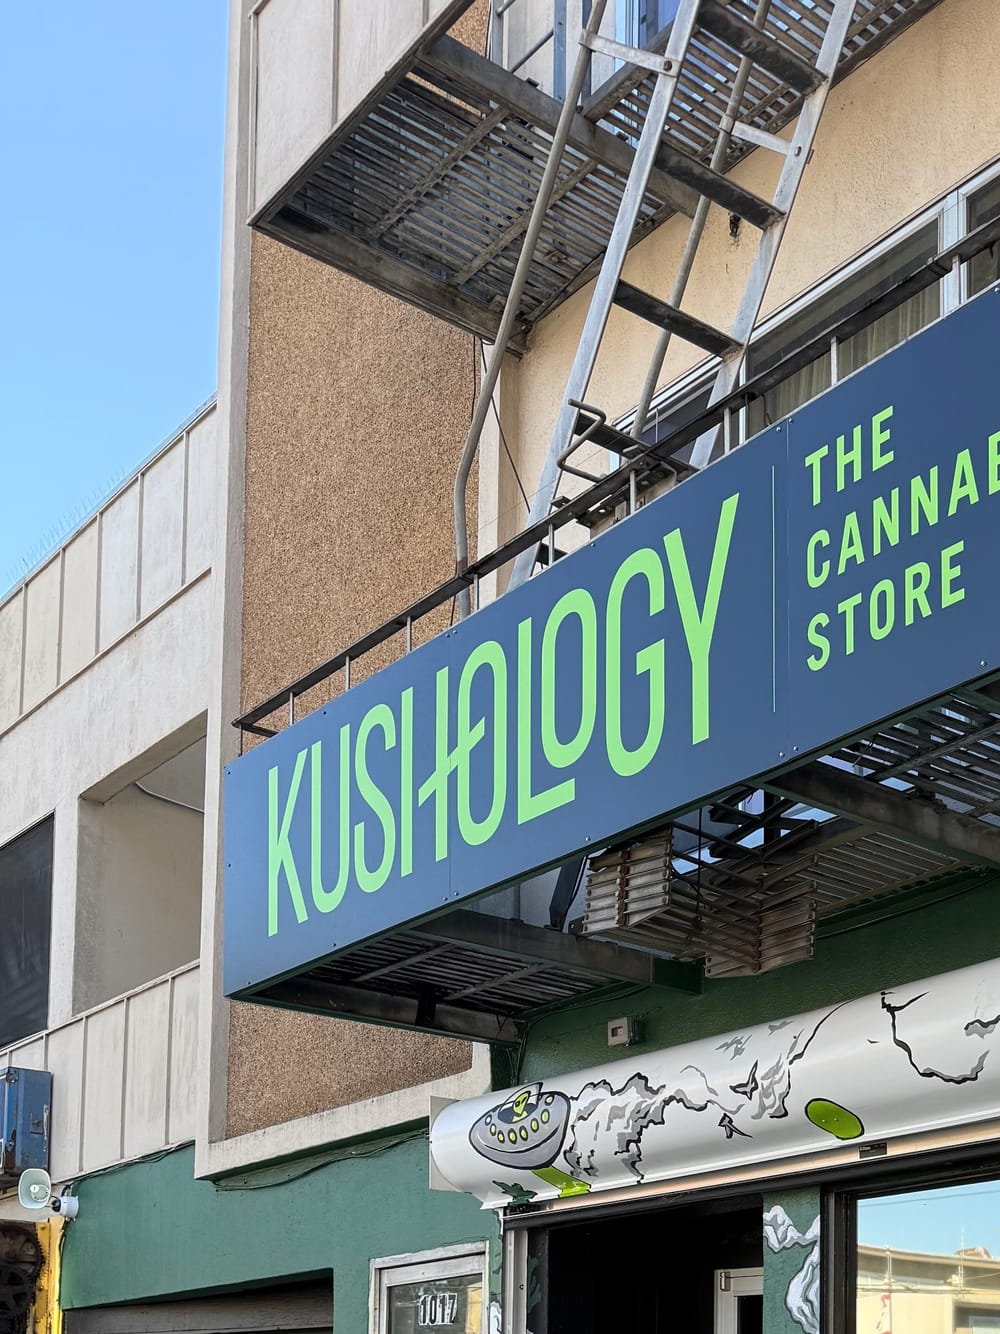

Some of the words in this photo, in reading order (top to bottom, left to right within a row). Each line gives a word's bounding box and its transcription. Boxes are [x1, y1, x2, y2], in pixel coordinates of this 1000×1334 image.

[804, 405, 896, 507] THE
[806, 540, 967, 673] STORE
[267, 492, 740, 937] KUSHOLOGY
[419, 1293, 458, 1326] 1017
